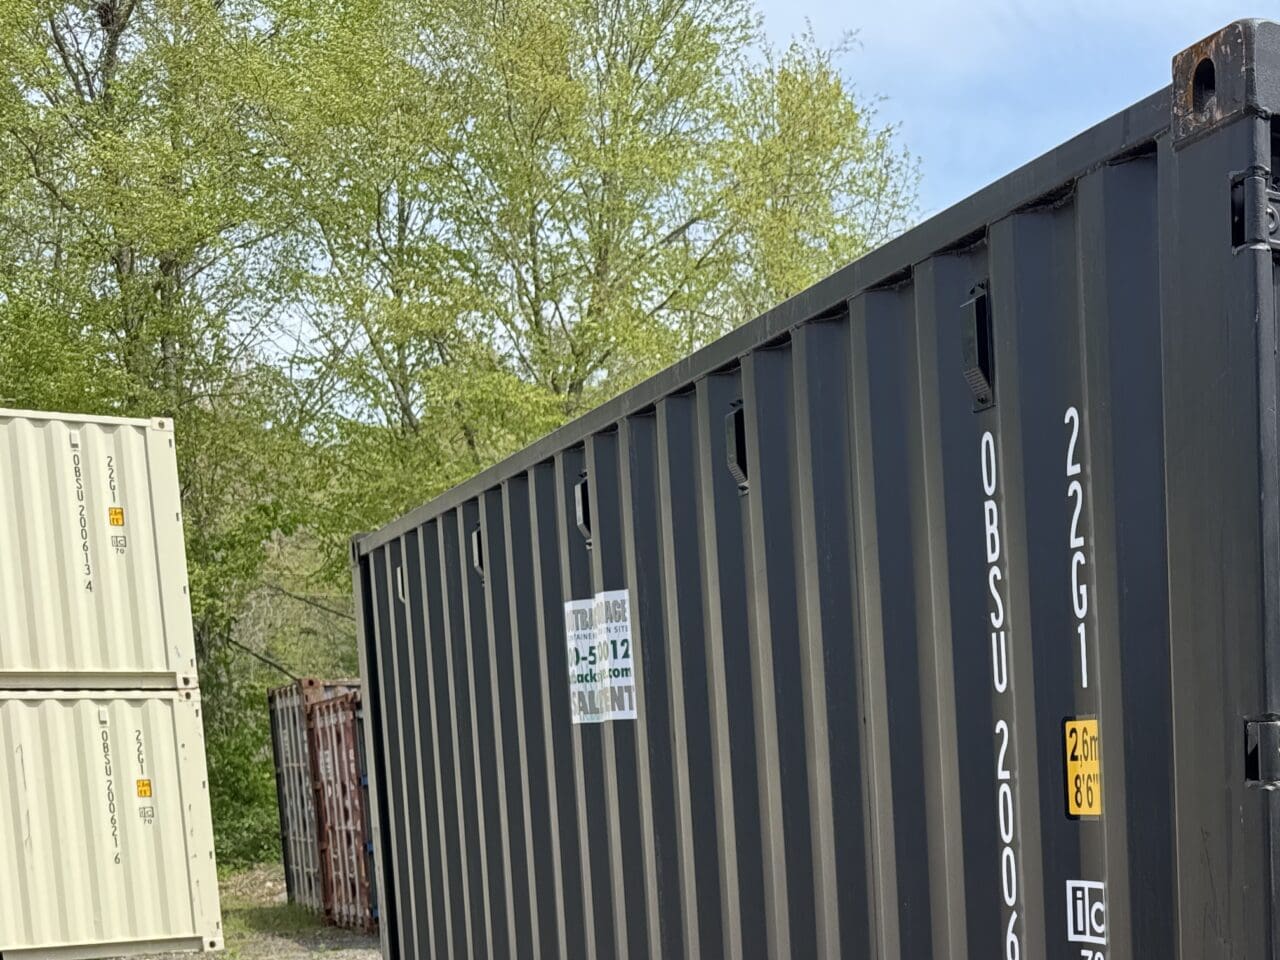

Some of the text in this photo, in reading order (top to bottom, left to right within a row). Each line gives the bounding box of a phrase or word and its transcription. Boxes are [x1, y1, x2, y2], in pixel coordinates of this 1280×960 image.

[73, 453, 84, 502] OBSU
[981, 431, 1008, 693] OBSU
[1064, 406, 1089, 689] 22G1
